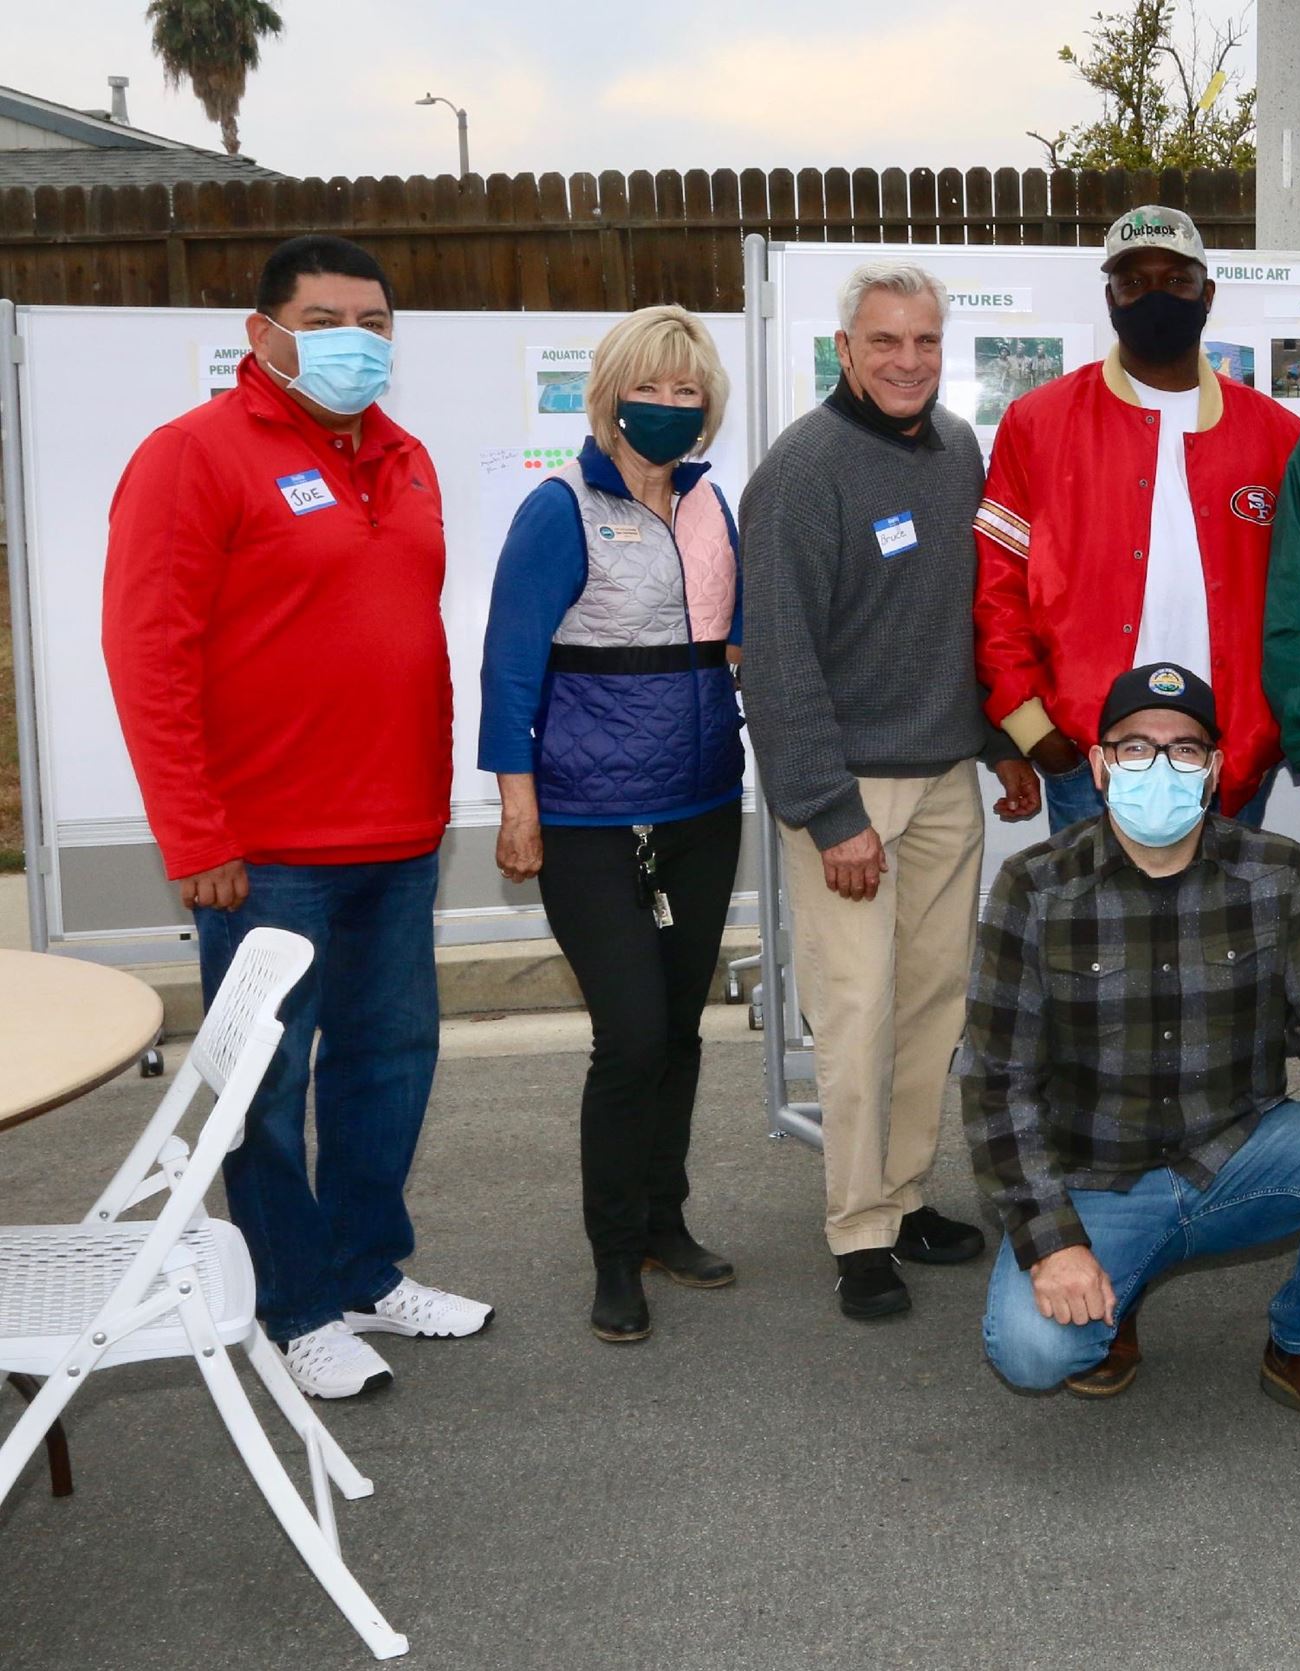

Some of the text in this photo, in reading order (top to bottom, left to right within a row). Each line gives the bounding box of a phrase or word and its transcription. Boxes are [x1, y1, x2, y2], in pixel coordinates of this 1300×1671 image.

[1216, 266, 1291, 281] PUBLIC ART
[214, 349, 251, 359] AMPH
[541, 350, 586, 361] AQUATIC
[290, 487, 325, 507] JOE
